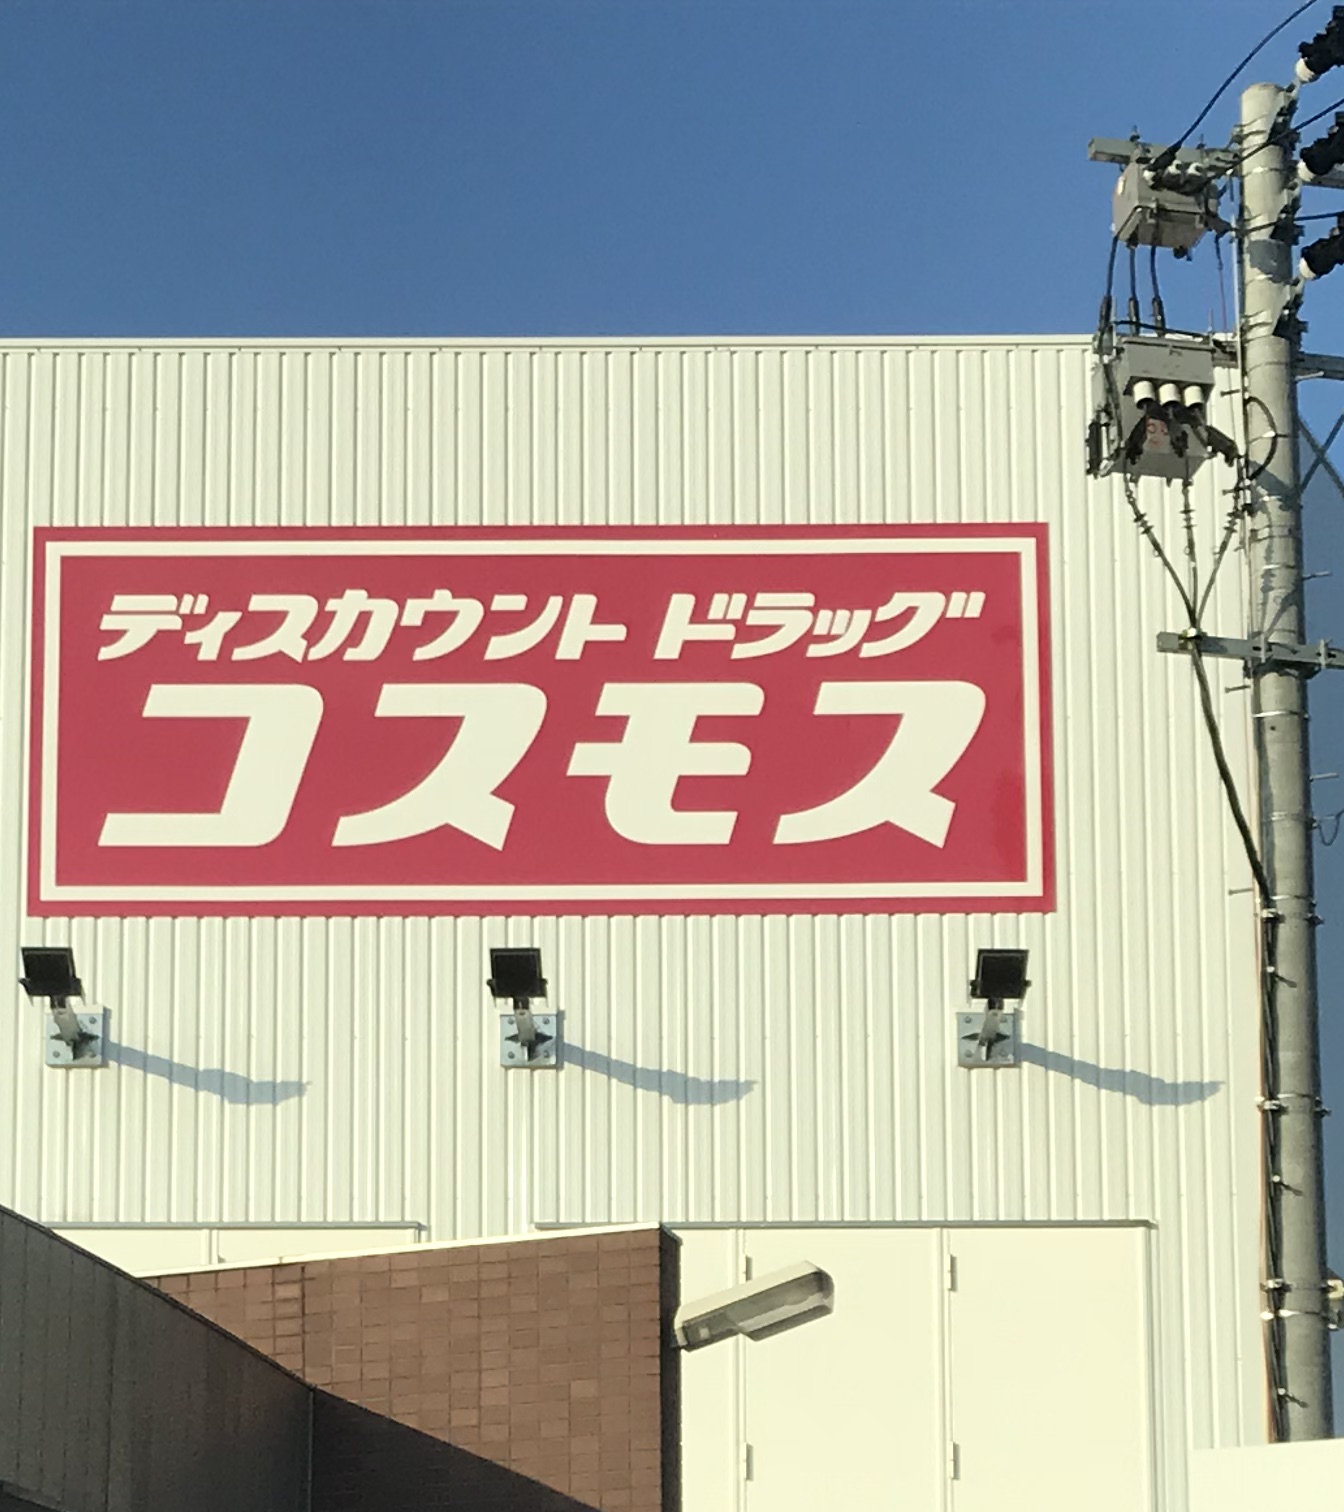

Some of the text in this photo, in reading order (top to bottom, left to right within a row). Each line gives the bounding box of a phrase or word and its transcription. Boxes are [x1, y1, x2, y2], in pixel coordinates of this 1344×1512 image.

[96, 588, 987, 662] ディスカウント ドラッグ
[96, 679, 988, 851] コスモス
